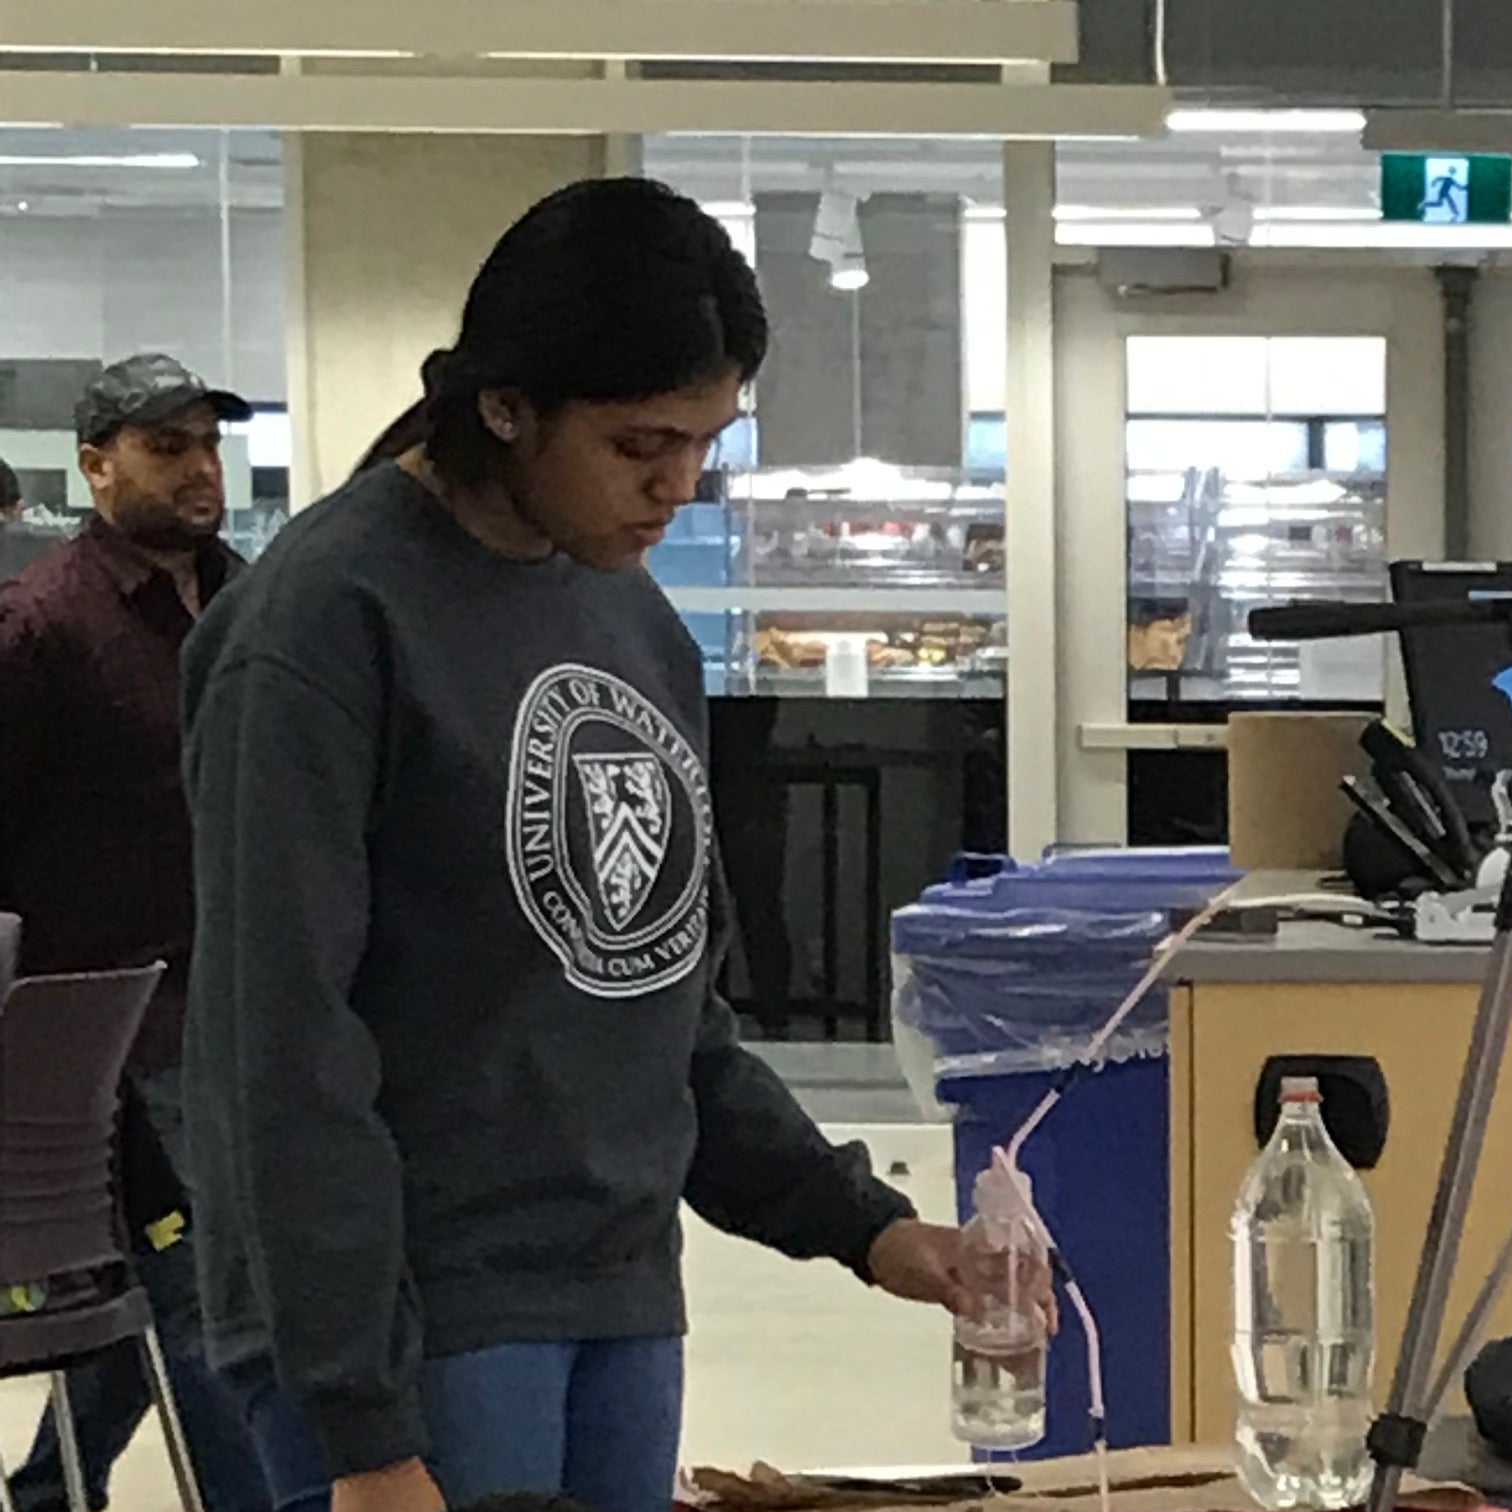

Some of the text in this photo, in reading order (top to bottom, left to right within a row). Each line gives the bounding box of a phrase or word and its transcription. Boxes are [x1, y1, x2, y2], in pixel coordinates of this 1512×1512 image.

[522, 684, 572, 883] UNIVERSITY
[568, 677, 601, 706] OF
[607, 952, 656, 977] CUM
